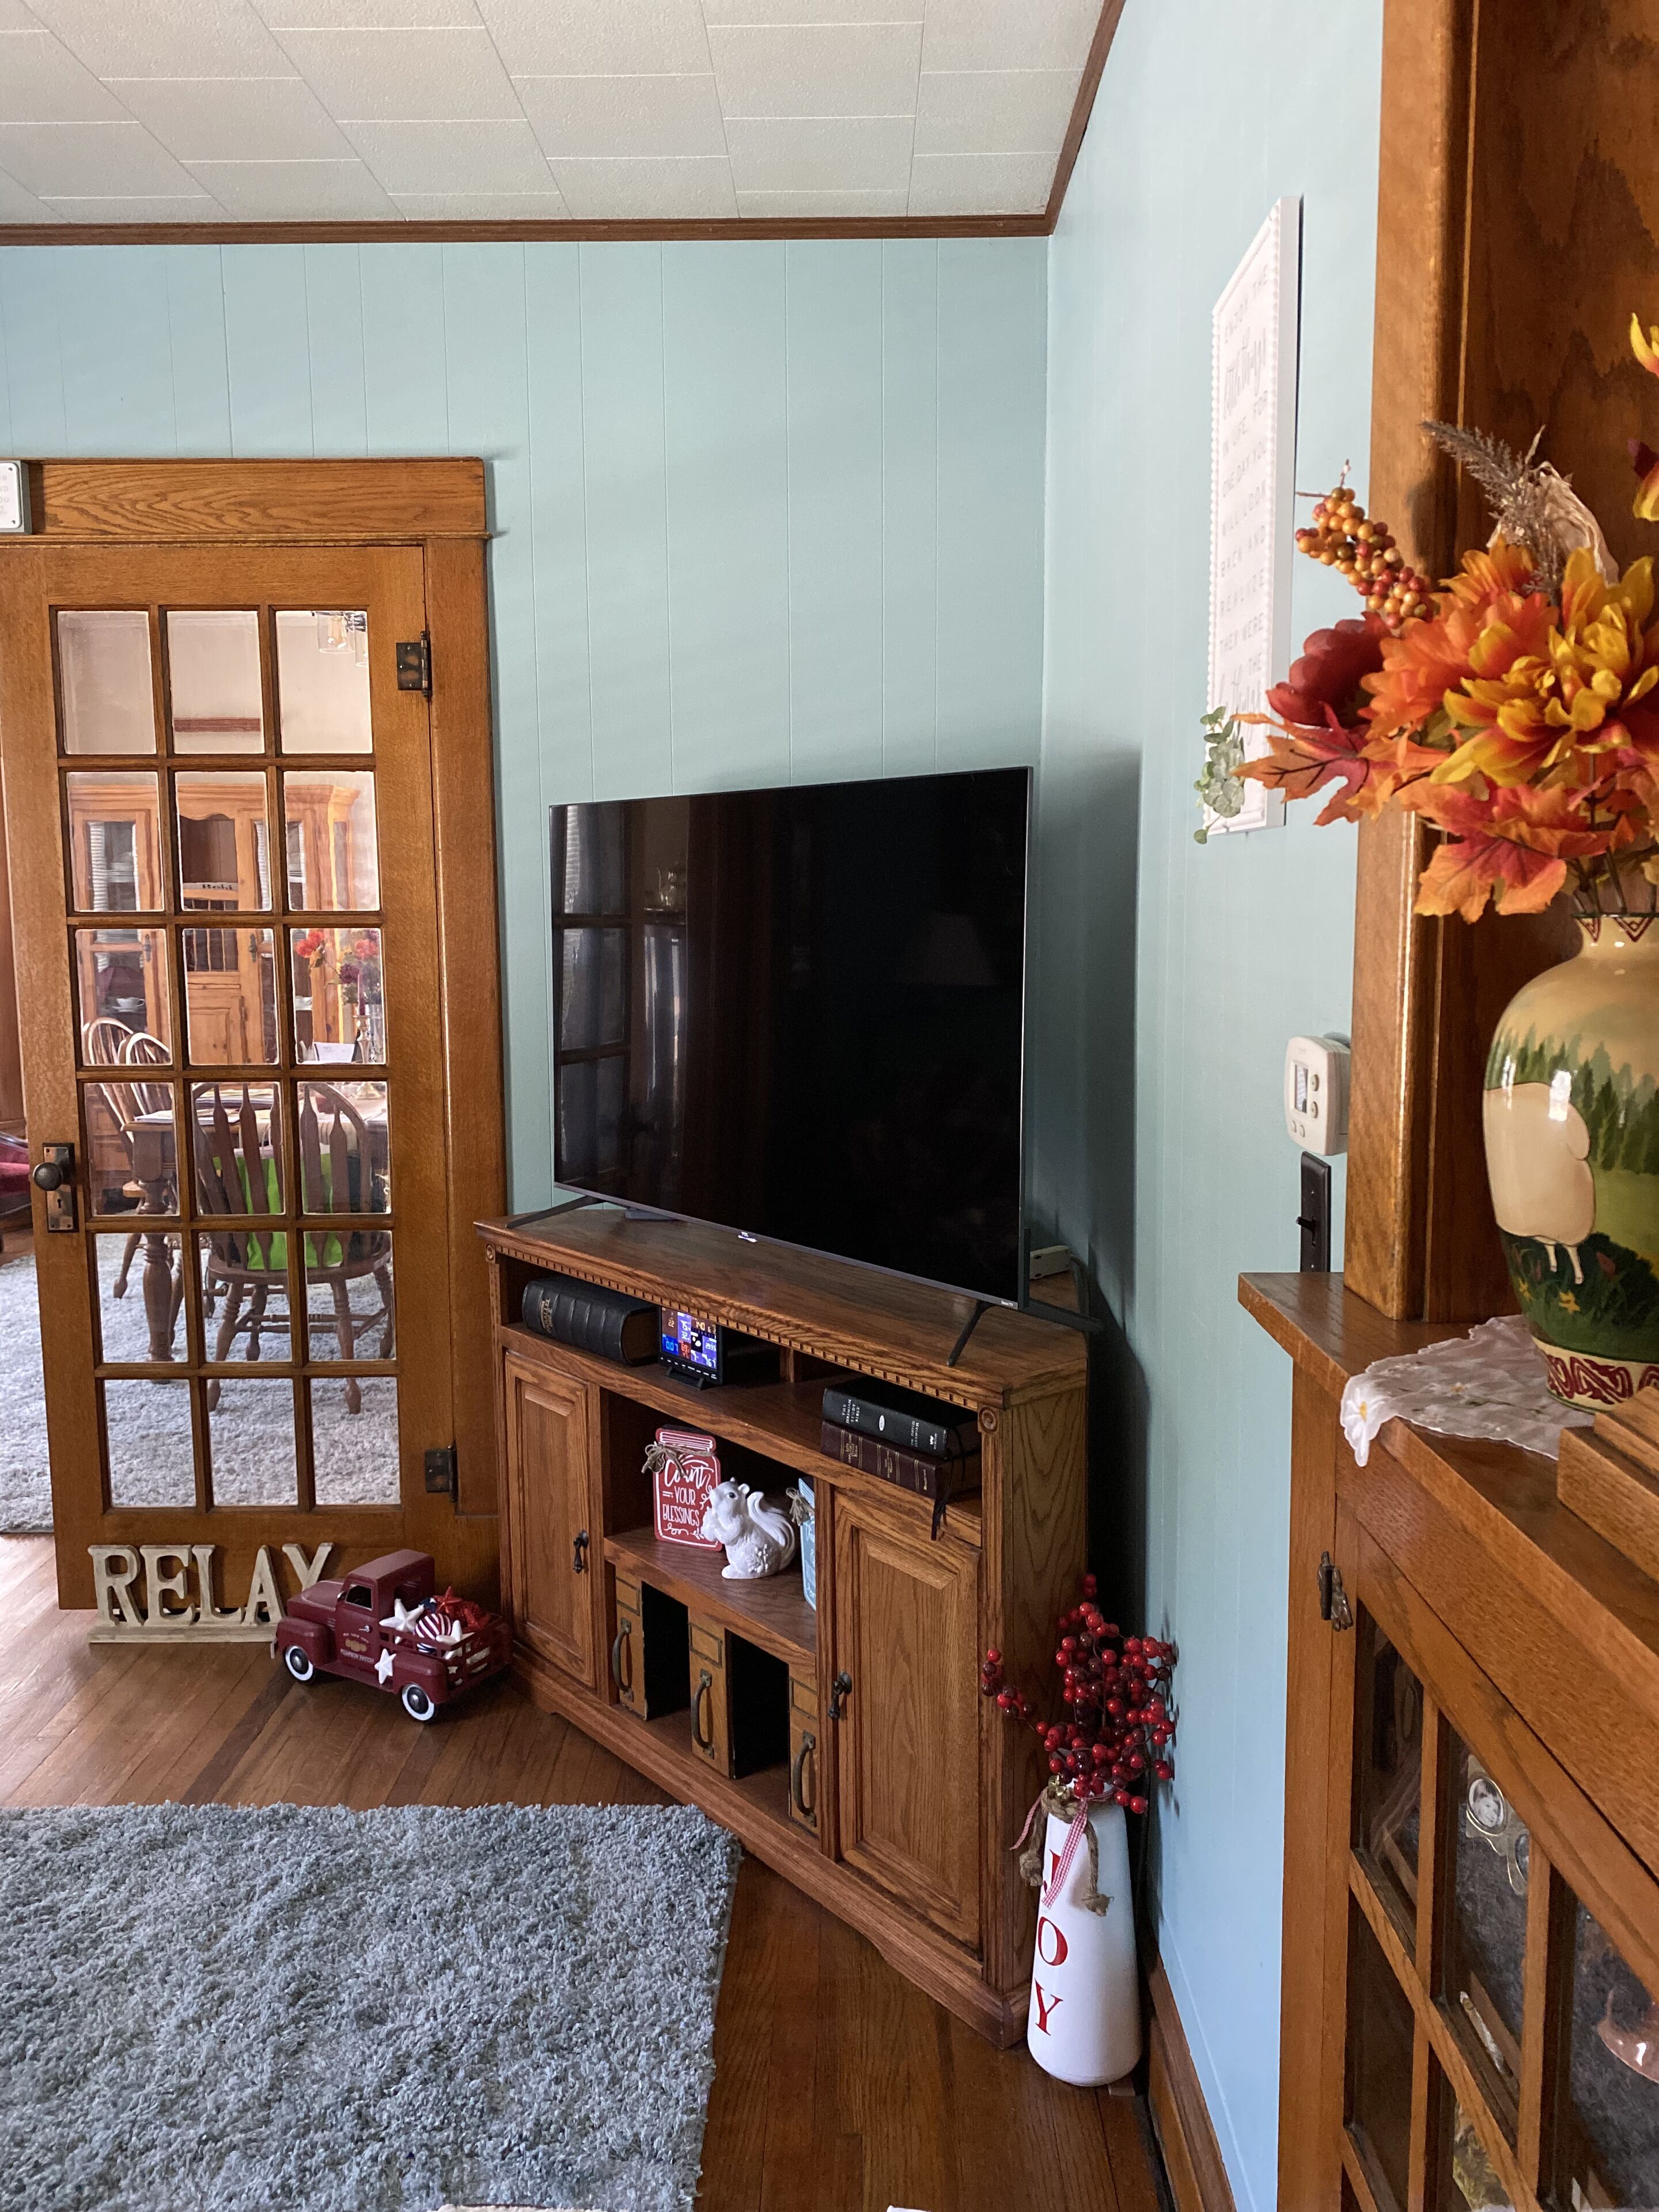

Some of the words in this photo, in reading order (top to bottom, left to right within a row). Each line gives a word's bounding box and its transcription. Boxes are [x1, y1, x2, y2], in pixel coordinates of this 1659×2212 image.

[1253, 264, 1268, 300] THE
[1232, 415, 1248, 446] LIFE
[1253, 389, 1268, 420] FOR
[1222, 471, 1234, 498] ONE
[1237, 452, 1250, 483] DAY
[1252, 435, 1267, 463] YOU
[1221, 547, 1243, 578] BACK
[1248, 525, 1266, 549] AND
[1220, 567, 1264, 617] REALIZE
[1219, 630, 1238, 657] THEY
[1242, 612, 1264, 642] WERE
[662, 1503, 700, 1527] BLESSINGS
[674, 1486, 696, 1506] YOUR
